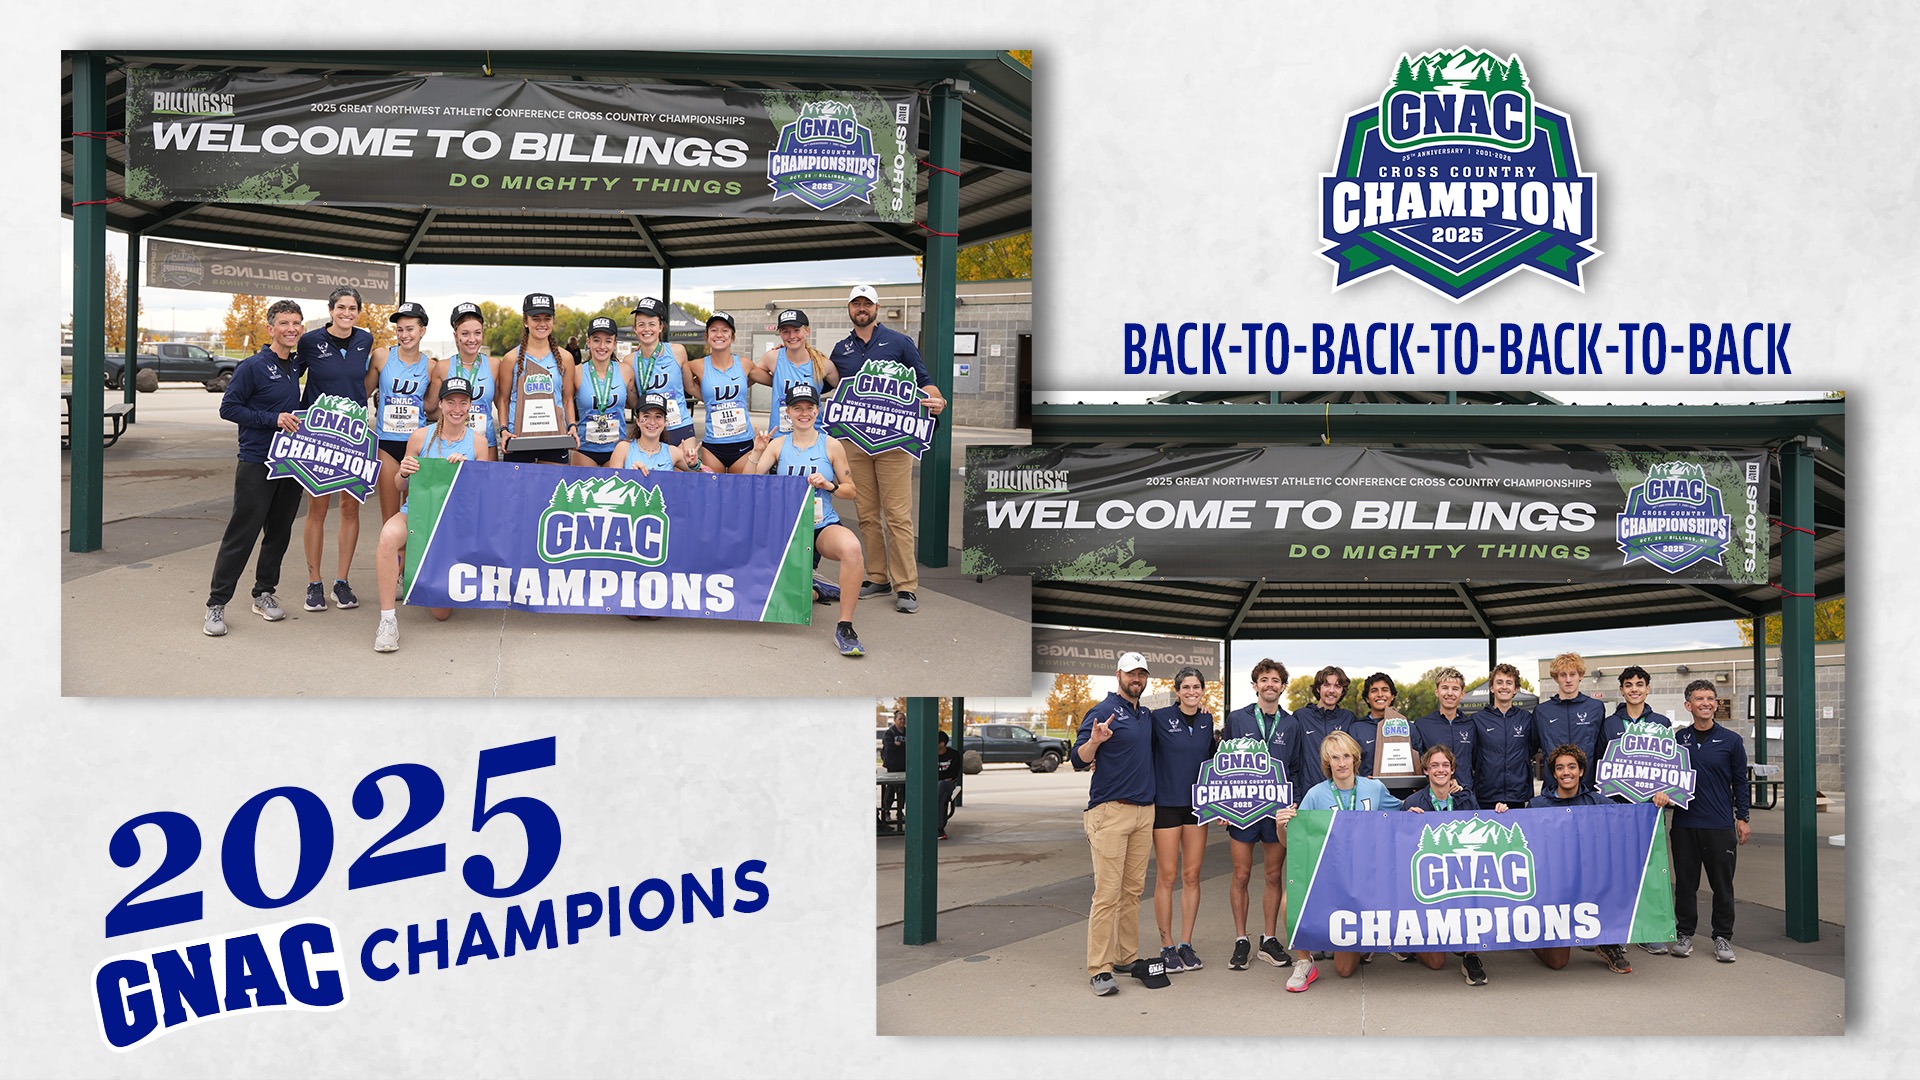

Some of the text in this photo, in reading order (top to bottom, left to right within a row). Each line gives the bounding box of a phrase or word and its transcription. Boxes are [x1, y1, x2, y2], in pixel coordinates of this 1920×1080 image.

[154, 91, 220, 113] BILLINGS
[310, 104, 746, 126] 2025 GREAT NORTHWEST ATHLETIC CONFERENCE CROSS COUNTRY CHAMPIONSHIPS
[800, 118, 854, 141] GNAC
[152, 121, 750, 168] WELCOME TO BILLINGS
[822, 148, 856, 156] COUNTRY
[772, 154, 876, 179] CHAMPIONSHIPS
[892, 126, 907, 212] SPORTS
[448, 173, 742, 196] DO MIGHTY THINGS
[526, 382, 550, 392] GNAC
[858, 375, 914, 402] GNAC
[391, 398, 413, 406] GNAC
[395, 406, 408, 414] 115
[846, 400, 871, 408] WOMEN'S
[872, 404, 890, 412] CROSS
[890, 407, 917, 416] COUNTRY
[310, 408, 364, 440] GNAC
[722, 410, 733, 418] 111
[828, 402, 931, 440] CHAMPION
[865, 426, 887, 436] 2025
[296, 434, 321, 445] WOMEN'S
[322, 441, 340, 450] CROSS
[340, 446, 366, 457] COUNTRY
[274, 436, 378, 483] CHAMPION
[312, 464, 334, 476] 2025
[986, 470, 1054, 491] BILLINGS
[1146, 477, 1592, 488] 2025 GREAT NORTHWEST ATHLETIC CONFERENCE CROSS COUNTRY CHAMPIONSHIPS
[1649, 480, 1703, 502] GNAC
[986, 500, 1597, 532] WELCOME TO BILLINGS
[546, 514, 661, 560] GNAC
[1621, 516, 1726, 540] CHAMPIONSHIPS
[1744, 485, 1758, 573] SPORTS
[1288, 544, 1591, 560] DO MIGHTY THINGS
[448, 562, 735, 613] CHAMPIONS
[1385, 726, 1408, 735] GNAC
[1624, 734, 1674, 756] GNAC
[1218, 753, 1267, 772] GNAC
[1600, 763, 1692, 790] CHAMPION
[1634, 781, 1654, 789] 2025
[1196, 782, 1288, 806] CHAMPION
[1418, 853, 1528, 896] GNAC
[1328, 902, 1601, 947] CHAMPIONS
